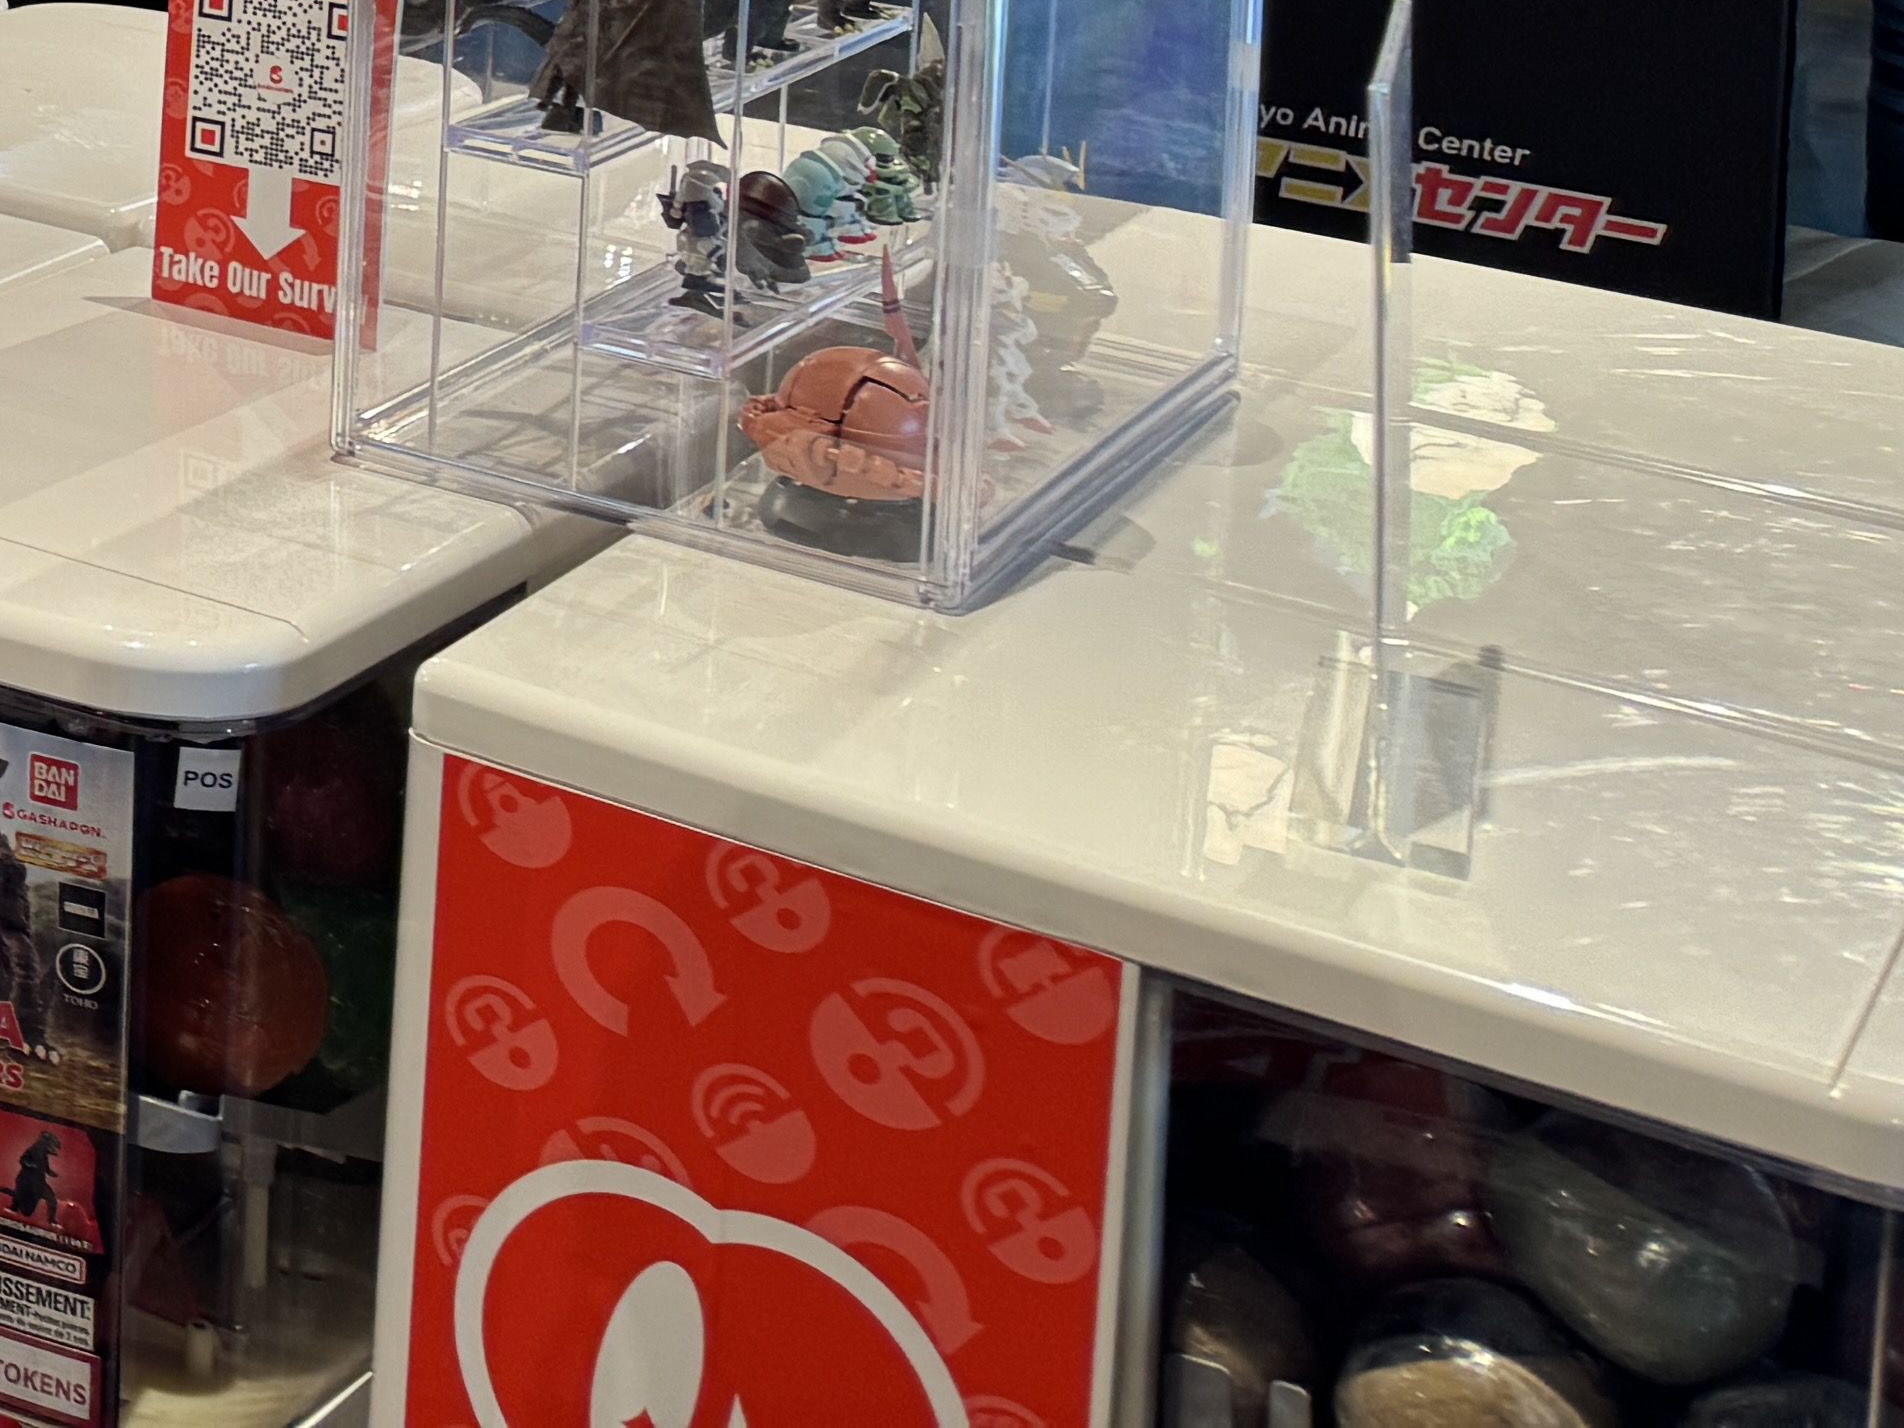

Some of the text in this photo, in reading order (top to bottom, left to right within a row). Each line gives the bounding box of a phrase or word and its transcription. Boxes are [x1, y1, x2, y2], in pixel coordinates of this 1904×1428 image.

[1418, 126, 1530, 168] Center
[159, 246, 341, 315] Take Our Surv
[32, 760, 74, 786] BAN
[183, 768, 234, 791] POS
[34, 781, 69, 804] DAI
